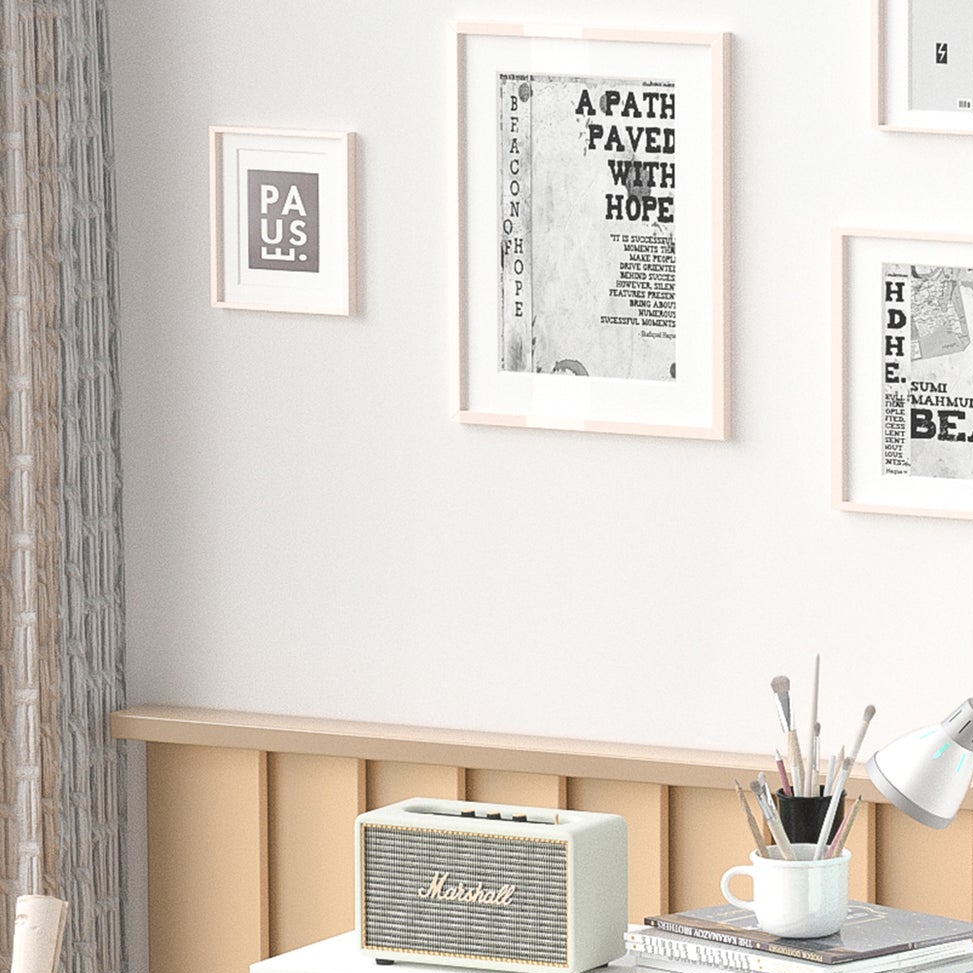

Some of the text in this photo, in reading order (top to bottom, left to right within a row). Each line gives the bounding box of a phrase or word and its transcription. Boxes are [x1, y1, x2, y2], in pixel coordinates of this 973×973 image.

[575, 89, 675, 119] A PATH
[588, 124, 675, 154] PAVED
[608, 159, 675, 188] WITH
[260, 184, 307, 216] PA
[605, 194, 674, 223] HOPE
[260, 218, 307, 246] US
[910, 381, 947, 393] SUMI
[418, 871, 516, 906] Marshall
